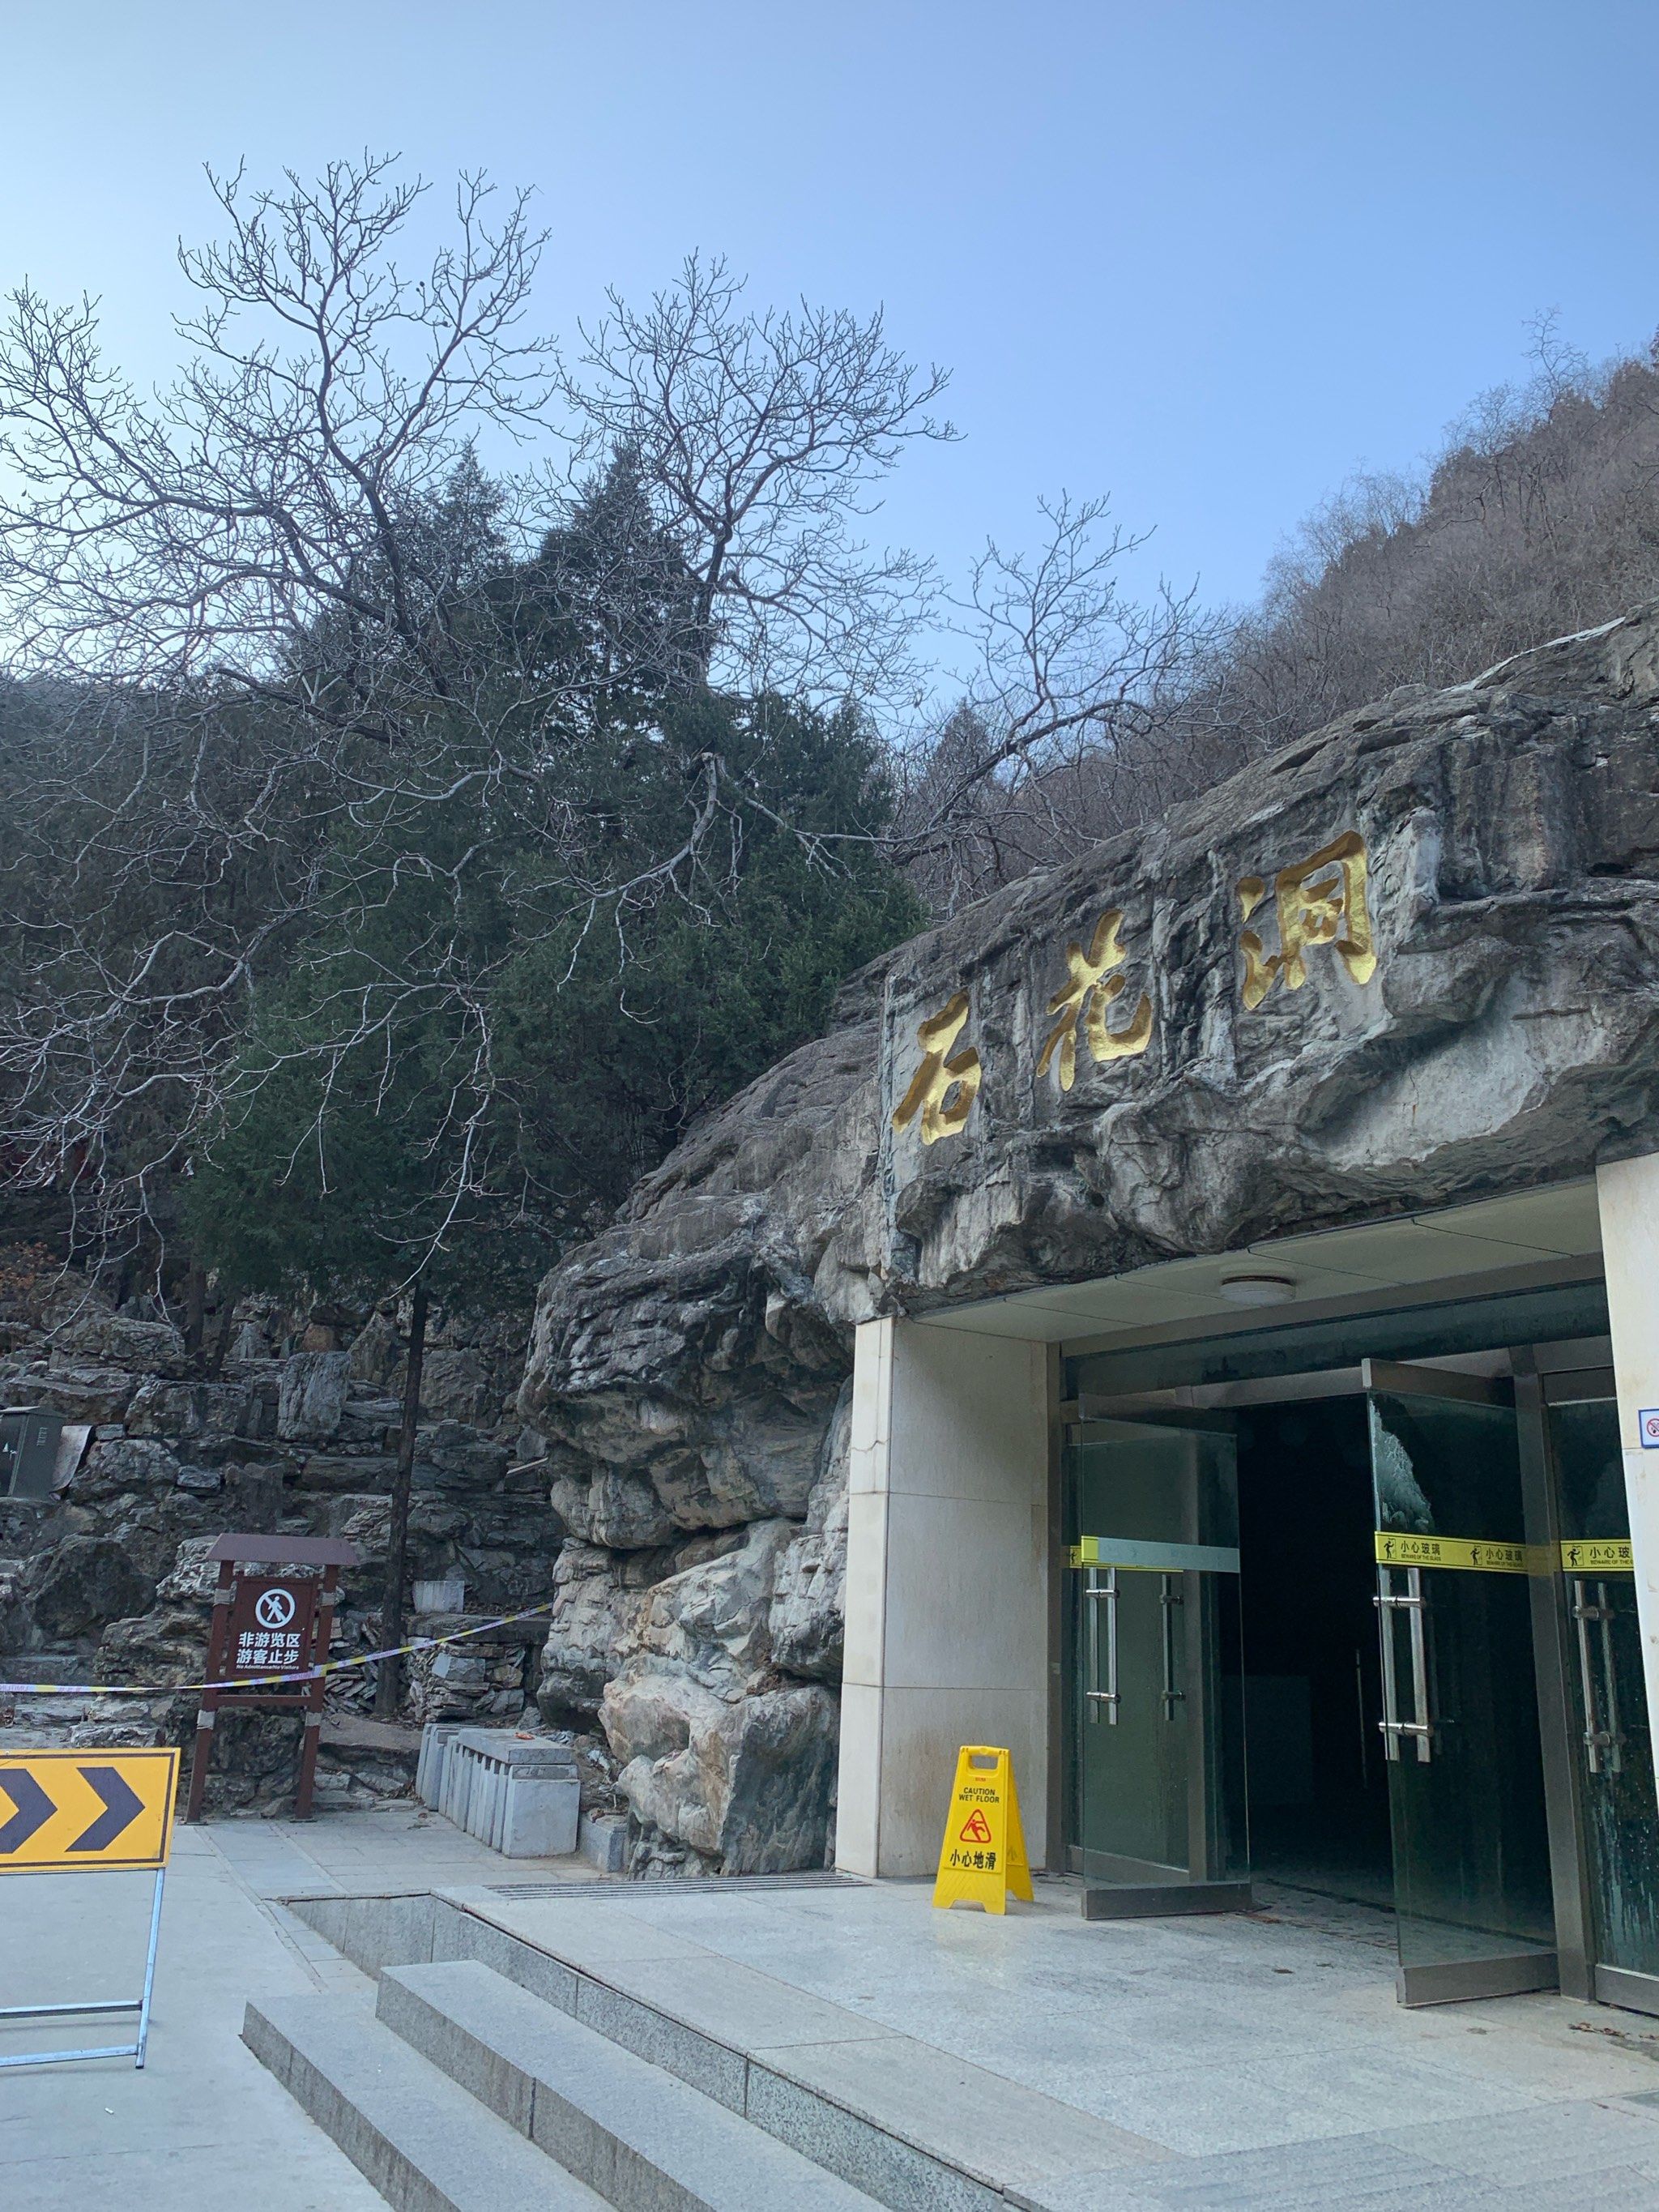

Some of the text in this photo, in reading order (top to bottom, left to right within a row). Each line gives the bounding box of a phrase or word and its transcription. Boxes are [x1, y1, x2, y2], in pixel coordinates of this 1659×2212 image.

[892, 829, 1377, 1147] 石花洞
[1401, 1540, 1440, 1555] 小心玻璃
[1486, 1548, 1523, 1561] 小心玻璃
[238, 1631, 301, 1648] 非游览区
[236, 1648, 299, 1665] 游客止步
[963, 1787, 996, 1796] CAUTION
[976, 1795, 1000, 1804] FLOOR
[949, 1848, 996, 1870] 小心地滑
